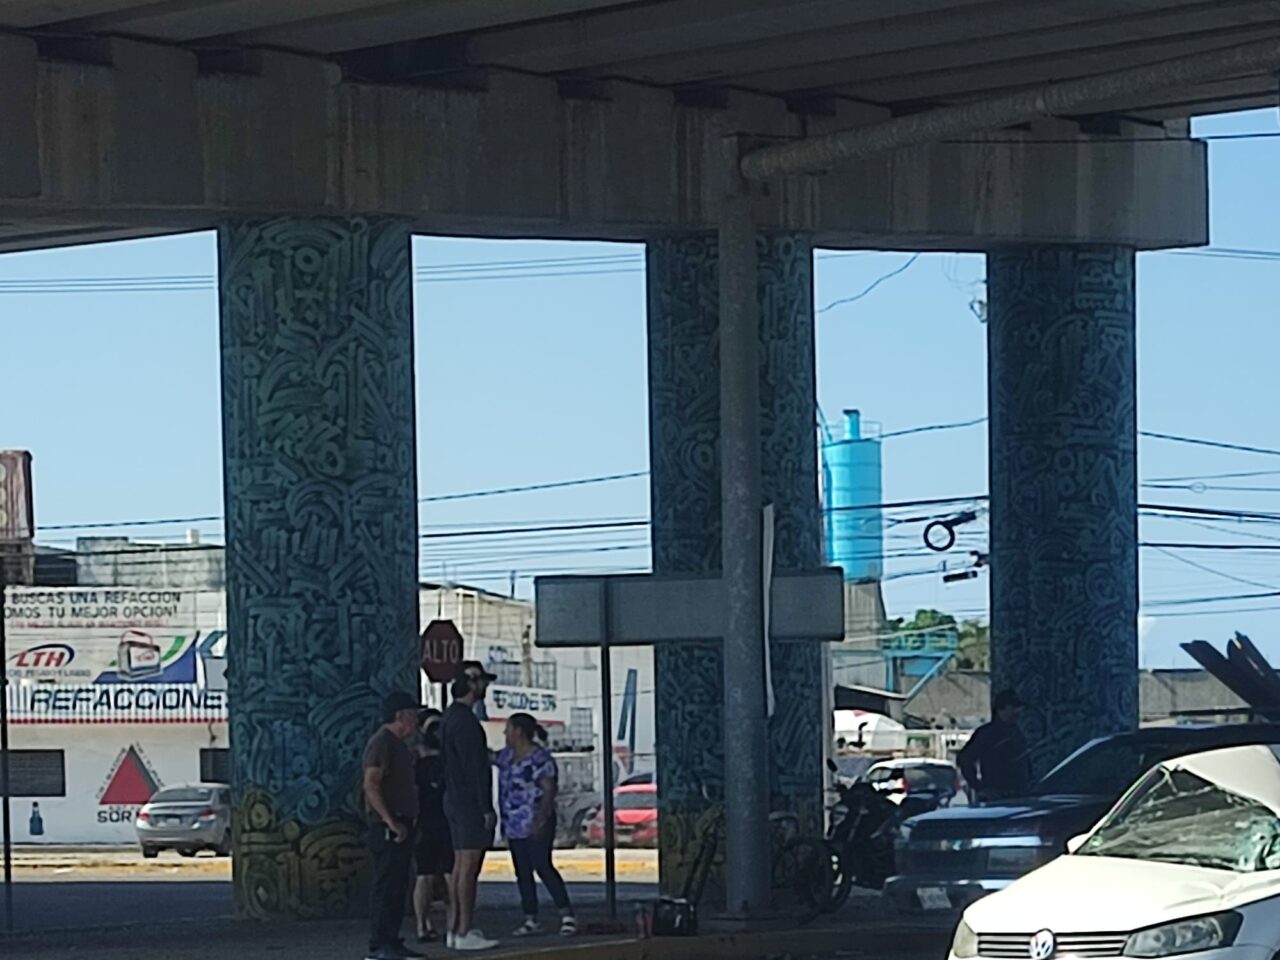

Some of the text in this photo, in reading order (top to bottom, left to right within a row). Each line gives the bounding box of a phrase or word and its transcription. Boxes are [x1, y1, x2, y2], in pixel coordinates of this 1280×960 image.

[12, 591, 181, 604] BUSCAS UNA REFACCION
[4, 607, 41, 619] OMOS
[50, 606, 65, 618] TU
[71, 606, 118, 618] MEJOR
[423, 639, 459, 663] ALTO
[16, 652, 65, 667] LTH
[31, 688, 228, 710] REFACCIONE
